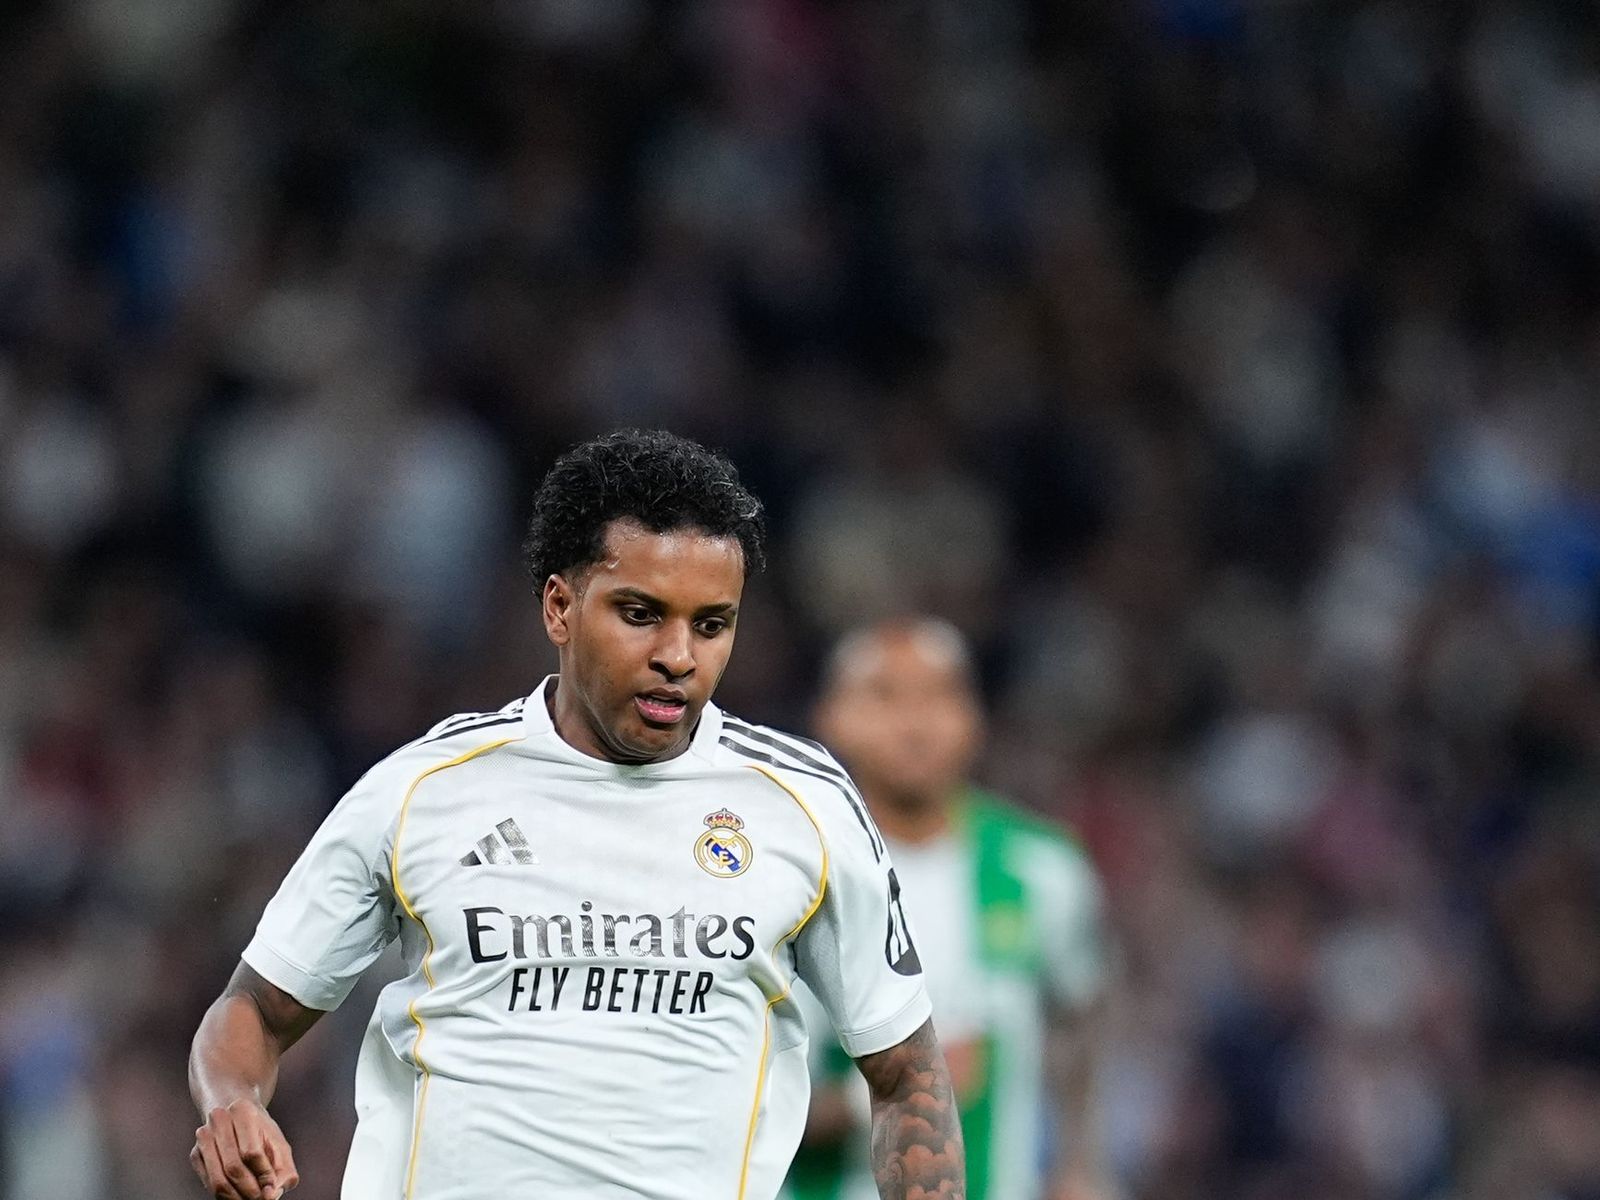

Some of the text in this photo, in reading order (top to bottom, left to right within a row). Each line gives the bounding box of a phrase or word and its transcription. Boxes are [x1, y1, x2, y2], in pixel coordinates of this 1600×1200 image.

[462, 901, 756, 964] Emirates
[508, 967, 714, 1014] FLY BETTER
